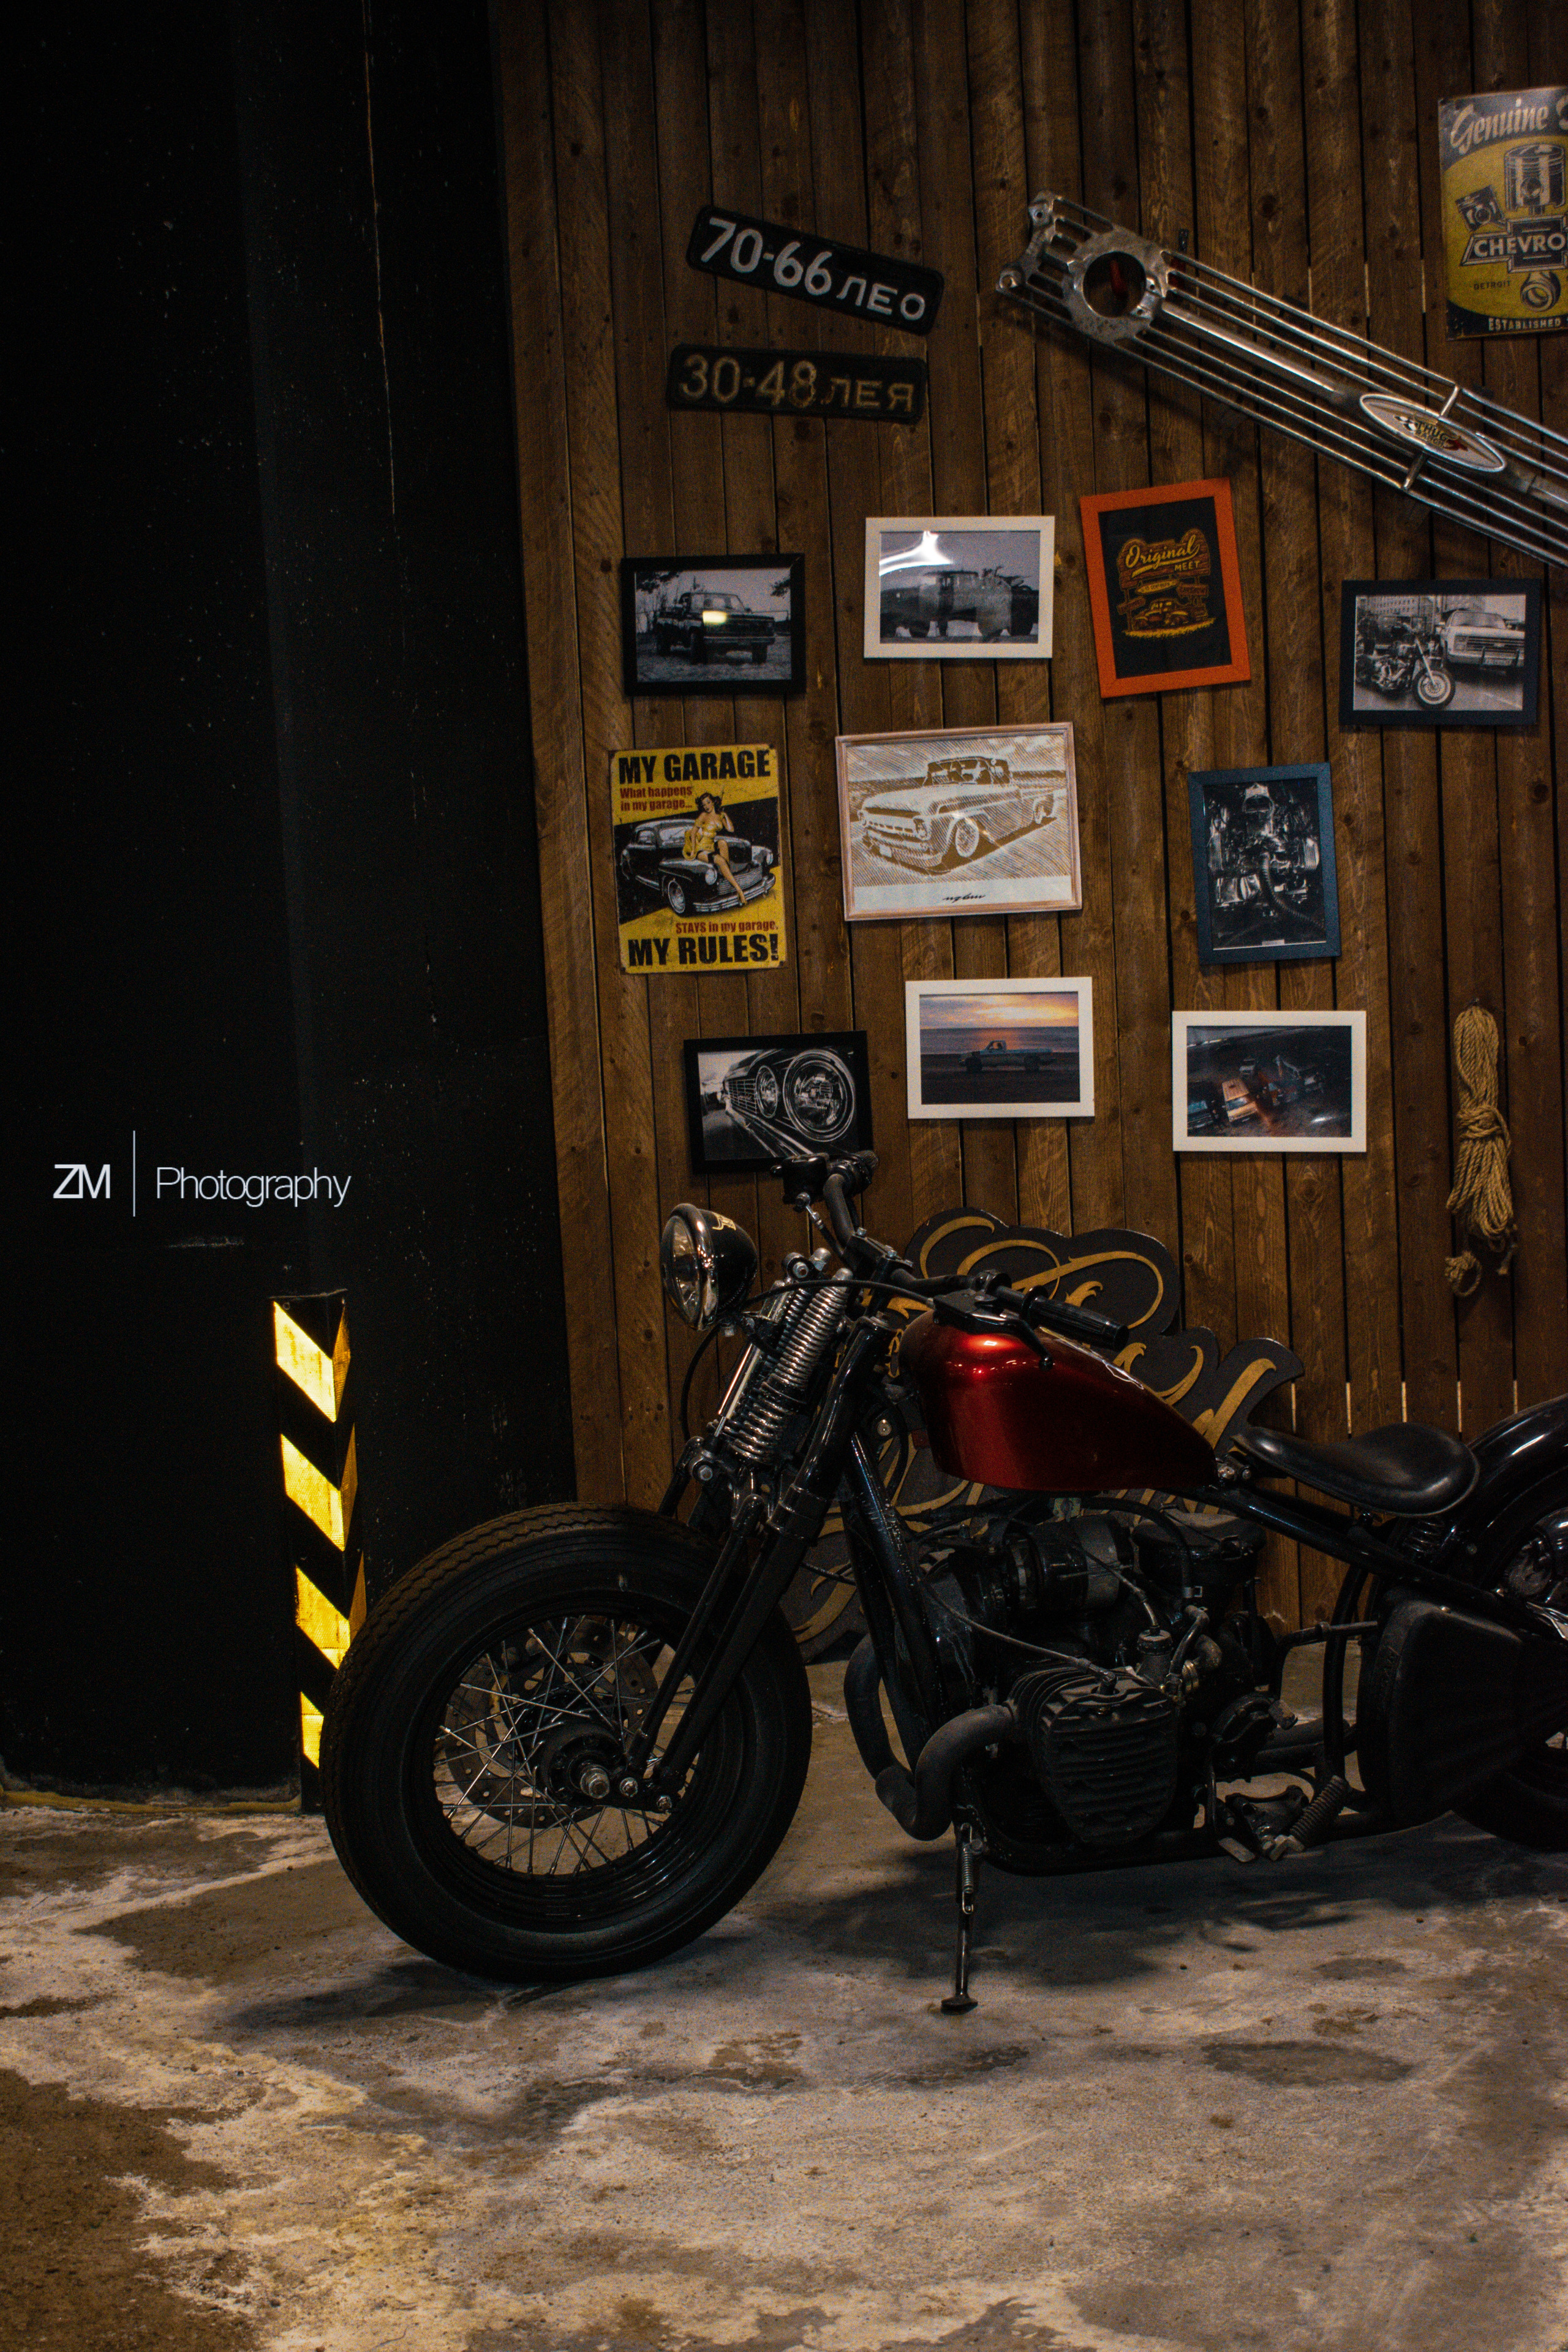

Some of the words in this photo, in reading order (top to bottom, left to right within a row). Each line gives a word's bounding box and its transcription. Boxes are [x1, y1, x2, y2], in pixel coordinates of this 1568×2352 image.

[1450, 98, 1549, 155] Genuine
[700, 217, 833, 296] 70-66
[1474, 281, 1510, 290] DETROIT
[1488, 317, 1561, 331] ESTABLISHED
[679, 353, 818, 409] 30-48
[1125, 534, 1200, 571] Original
[1174, 560, 1200, 571] MEET
[619, 756, 656, 784] MY
[664, 750, 771, 782] GARAGE
[620, 787, 646, 799] What
[648, 785, 693, 799] happens
[632, 802, 648, 813] my
[676, 921, 707, 933] STAYS
[709, 921, 718, 932] in
[720, 922, 736, 934] my
[738, 920, 778, 934] garage.
[628, 938, 671, 967] MY
[679, 933, 779, 965] RULES!
